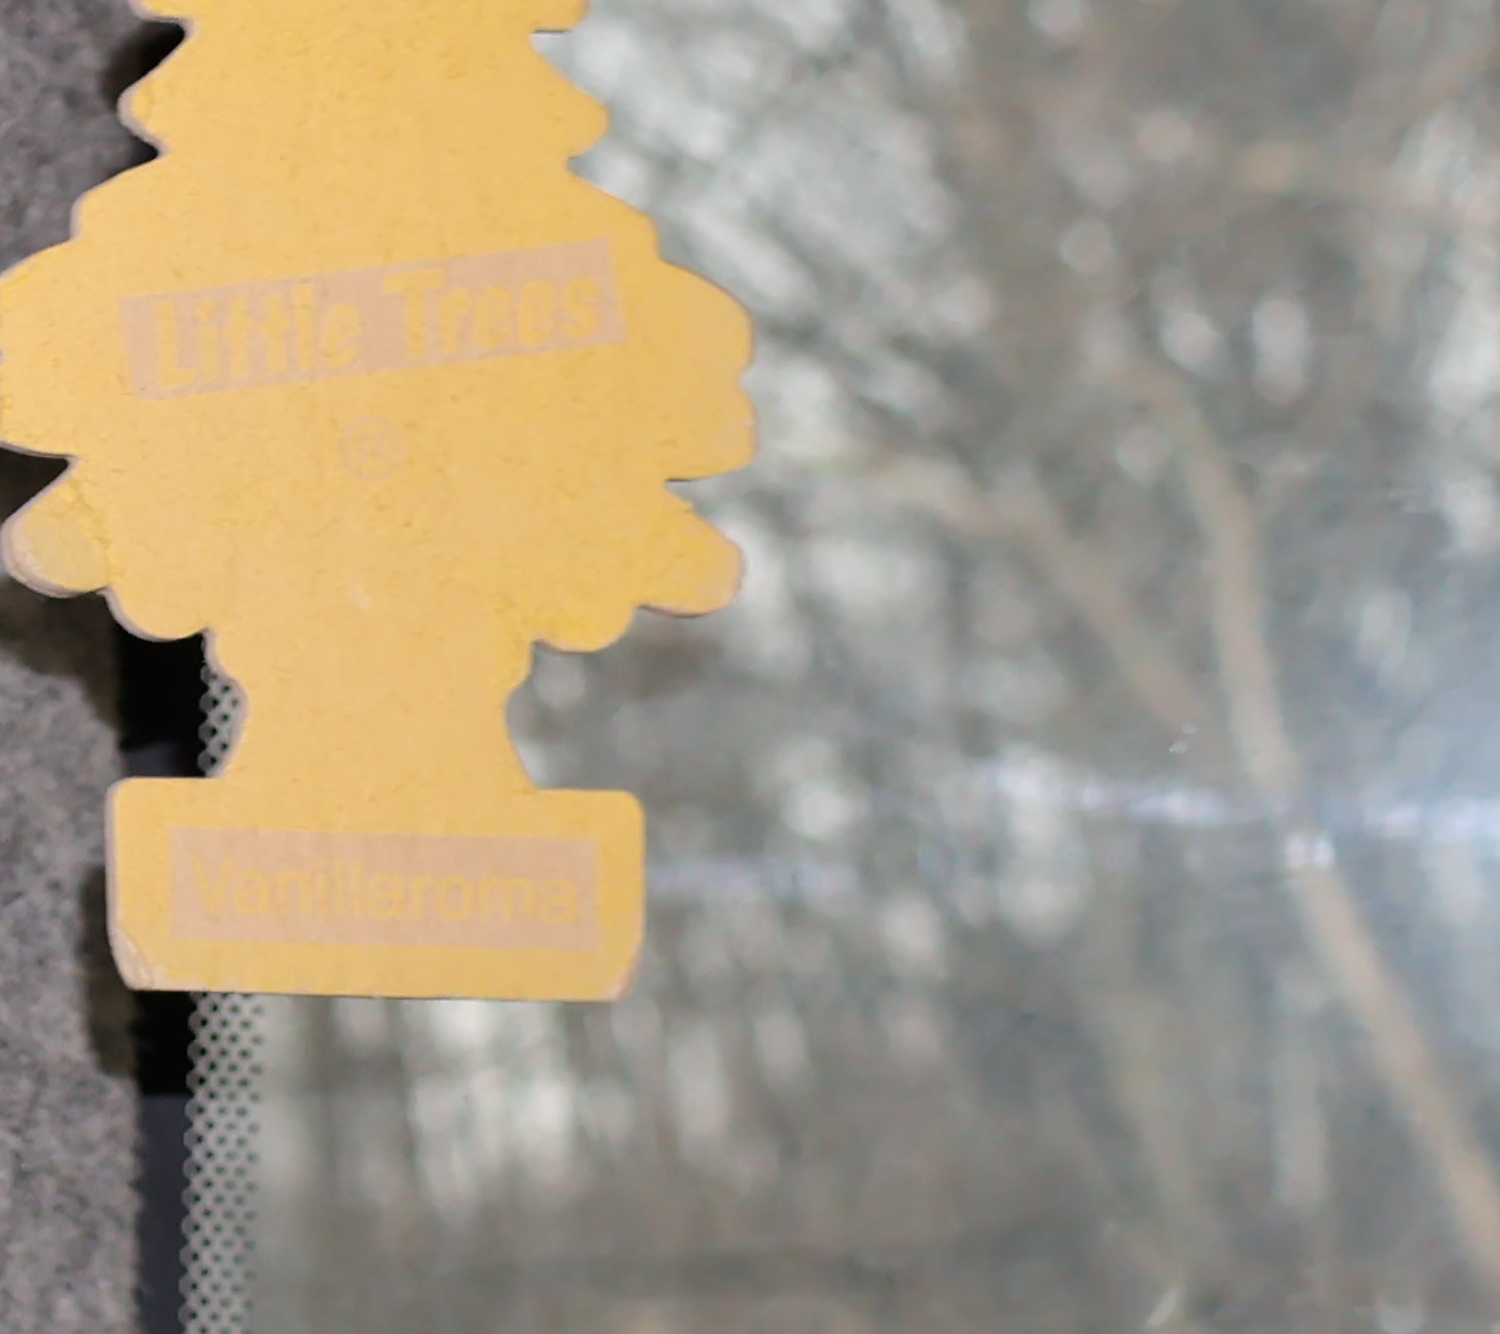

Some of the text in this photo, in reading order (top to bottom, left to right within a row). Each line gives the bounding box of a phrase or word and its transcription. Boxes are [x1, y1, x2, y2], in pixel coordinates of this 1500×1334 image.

[155, 266, 600, 391] Little Trees
[190, 853, 580, 925] Vanillaroma
